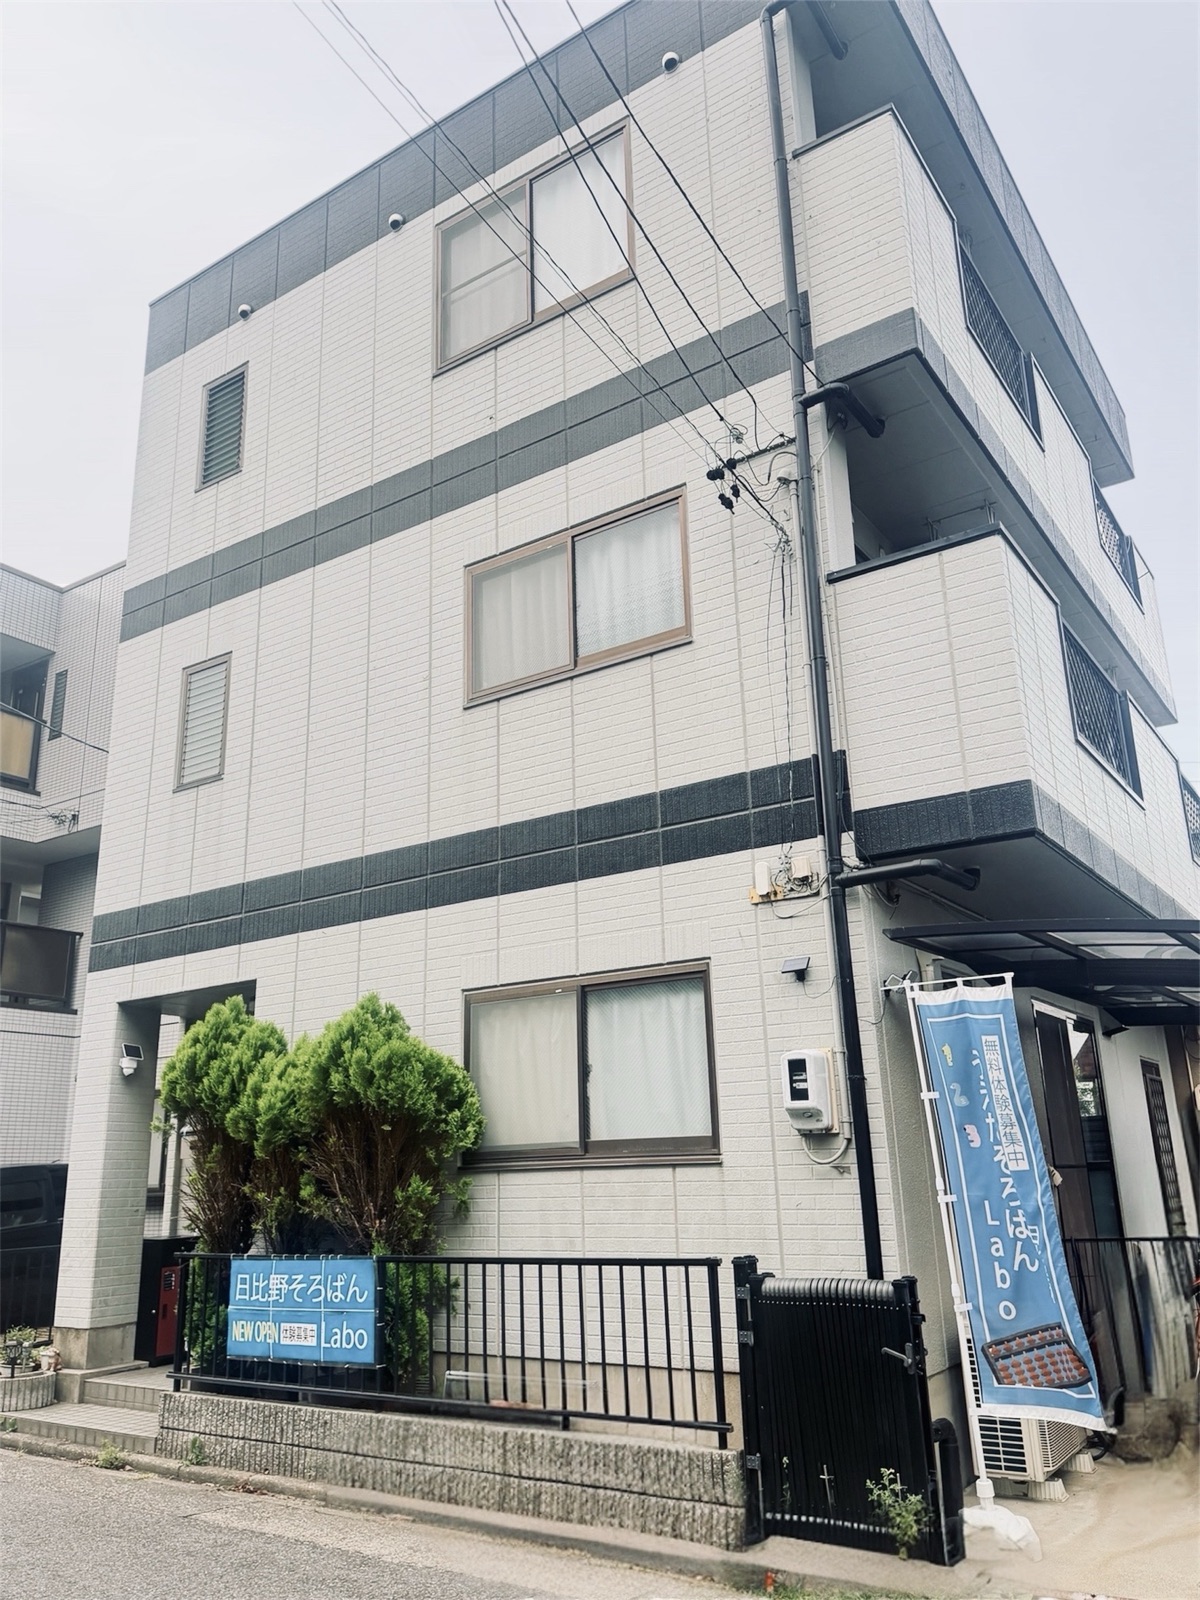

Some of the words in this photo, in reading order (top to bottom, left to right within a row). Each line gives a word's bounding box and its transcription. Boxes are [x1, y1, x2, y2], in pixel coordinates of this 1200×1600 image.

[984, 1038, 1025, 1167] 無料体験募集中
[983, 1199, 1017, 1321] Labo
[235, 1272, 368, 1303] 日比野そろばん
[232, 1320, 254, 1342] NEW
[254, 1321, 279, 1344] OPEN
[281, 1324, 316, 1343] 体験募集中
[322, 1320, 368, 1350] Labo
